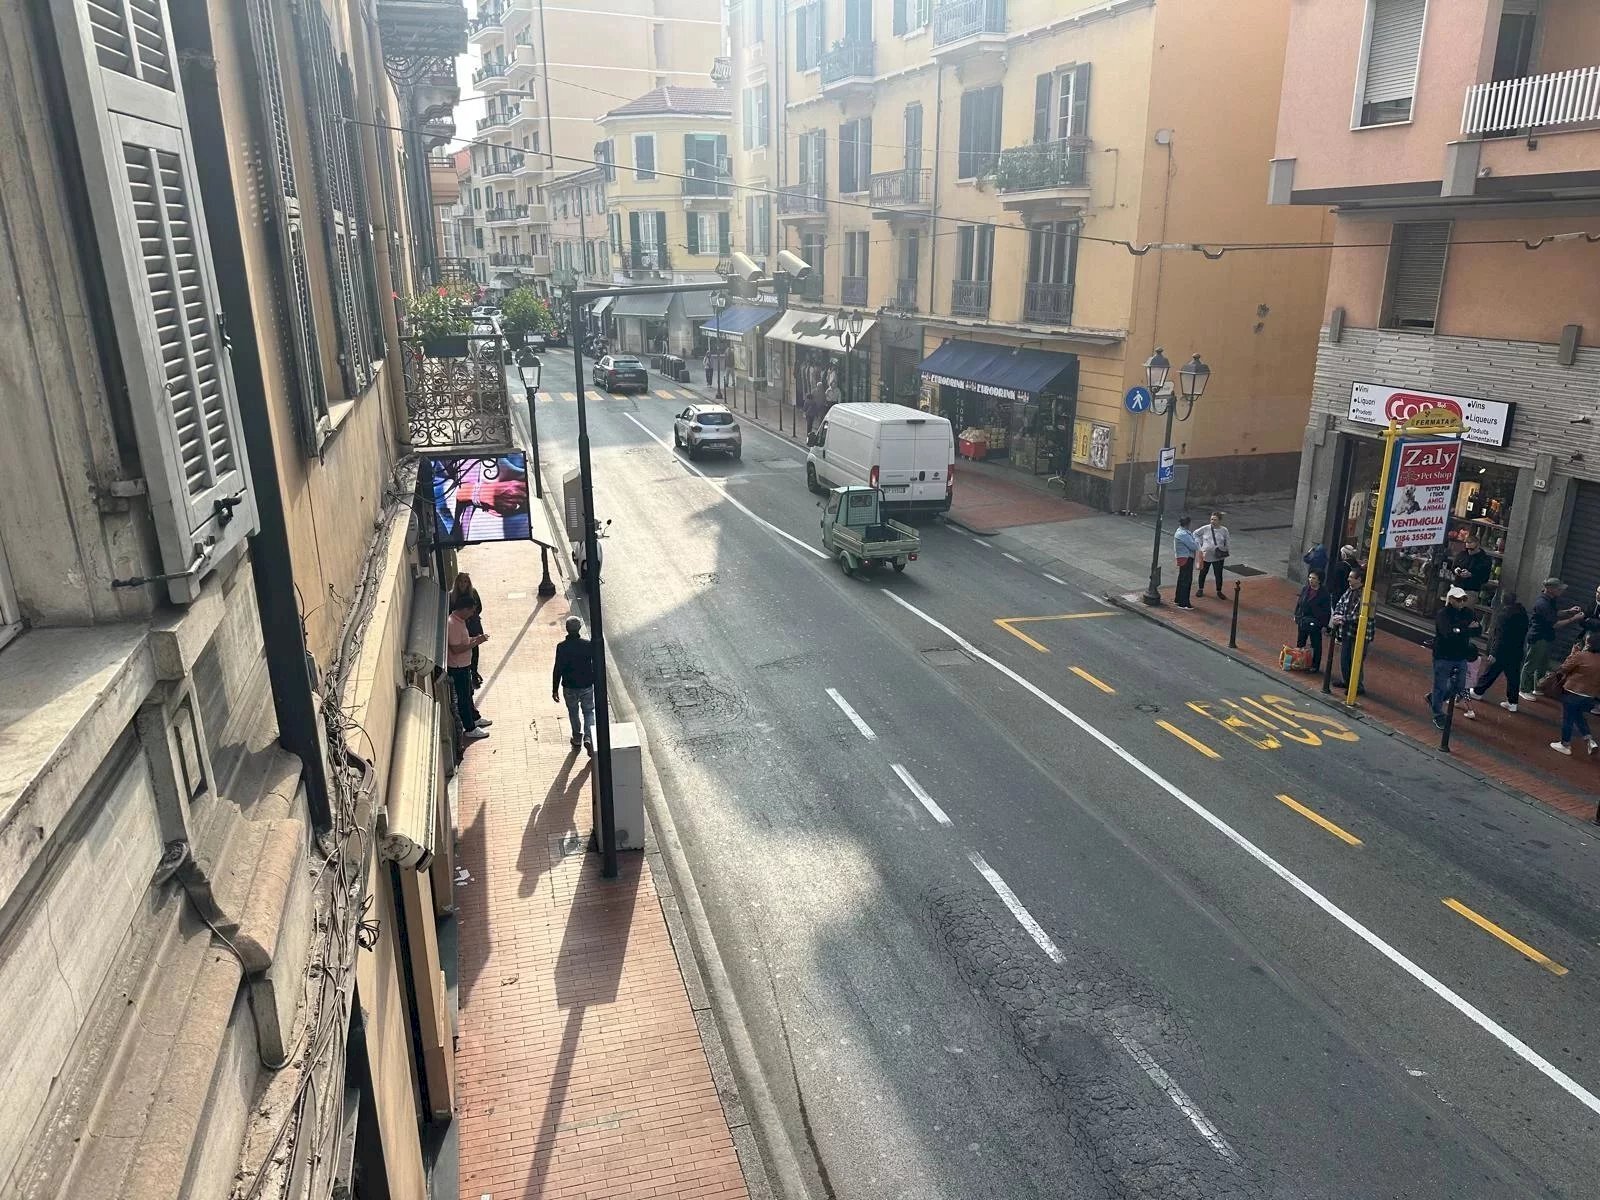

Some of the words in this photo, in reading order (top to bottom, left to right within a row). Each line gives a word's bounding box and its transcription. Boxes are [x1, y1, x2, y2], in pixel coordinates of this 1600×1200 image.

[976, 383, 1016, 400] EURODRINK
[1358, 385, 1369, 393] Vini
[1471, 399, 1486, 410] Vins
[1415, 417, 1450, 426] FERMATA
[1470, 414, 1498, 426] Liqueurs
[1466, 434, 1499, 445] Alimentaires
[1404, 448, 1456, 470] Zaly
[1420, 472, 1432, 480] Pet
[1433, 471, 1452, 480] Shop
[1391, 516, 1443, 528] VENTIMIGLIA
[1411, 532, 1436, 542] 355829
[1185, 694, 1360, 750] BUS
